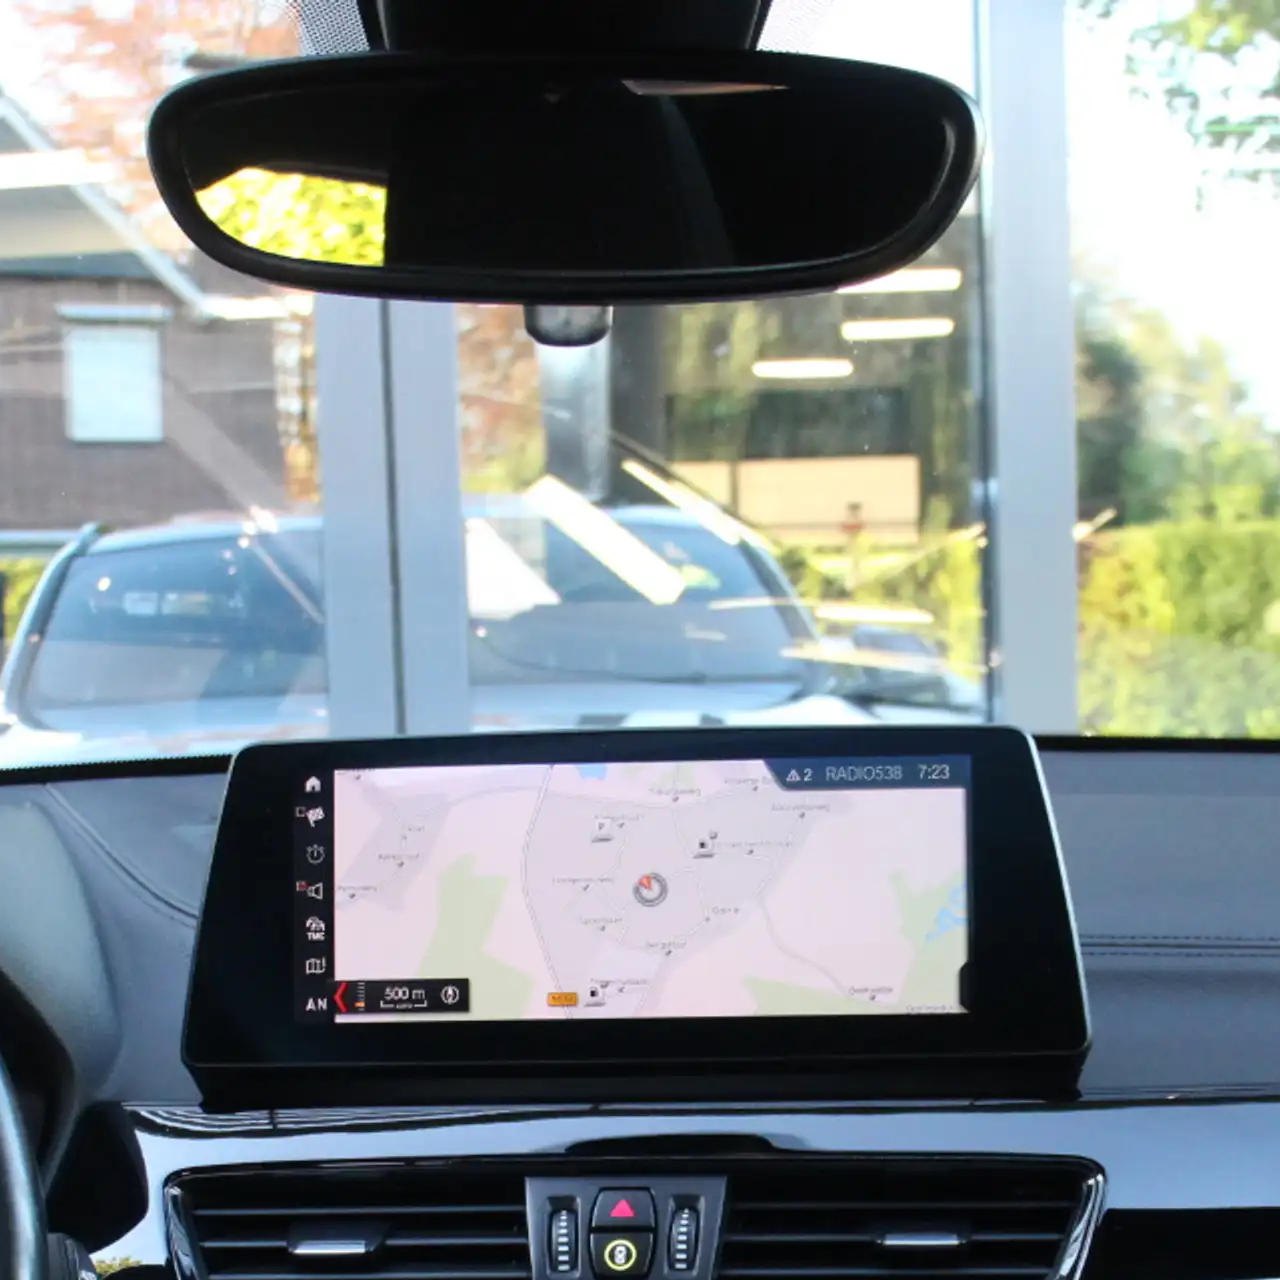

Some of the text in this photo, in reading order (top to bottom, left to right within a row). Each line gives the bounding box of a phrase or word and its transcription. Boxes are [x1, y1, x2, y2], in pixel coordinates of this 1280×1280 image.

[803, 764, 950, 782] 2 RADIO538 7:23
[384, 987, 426, 1001] 500 m
[306, 996, 328, 1012] AN
